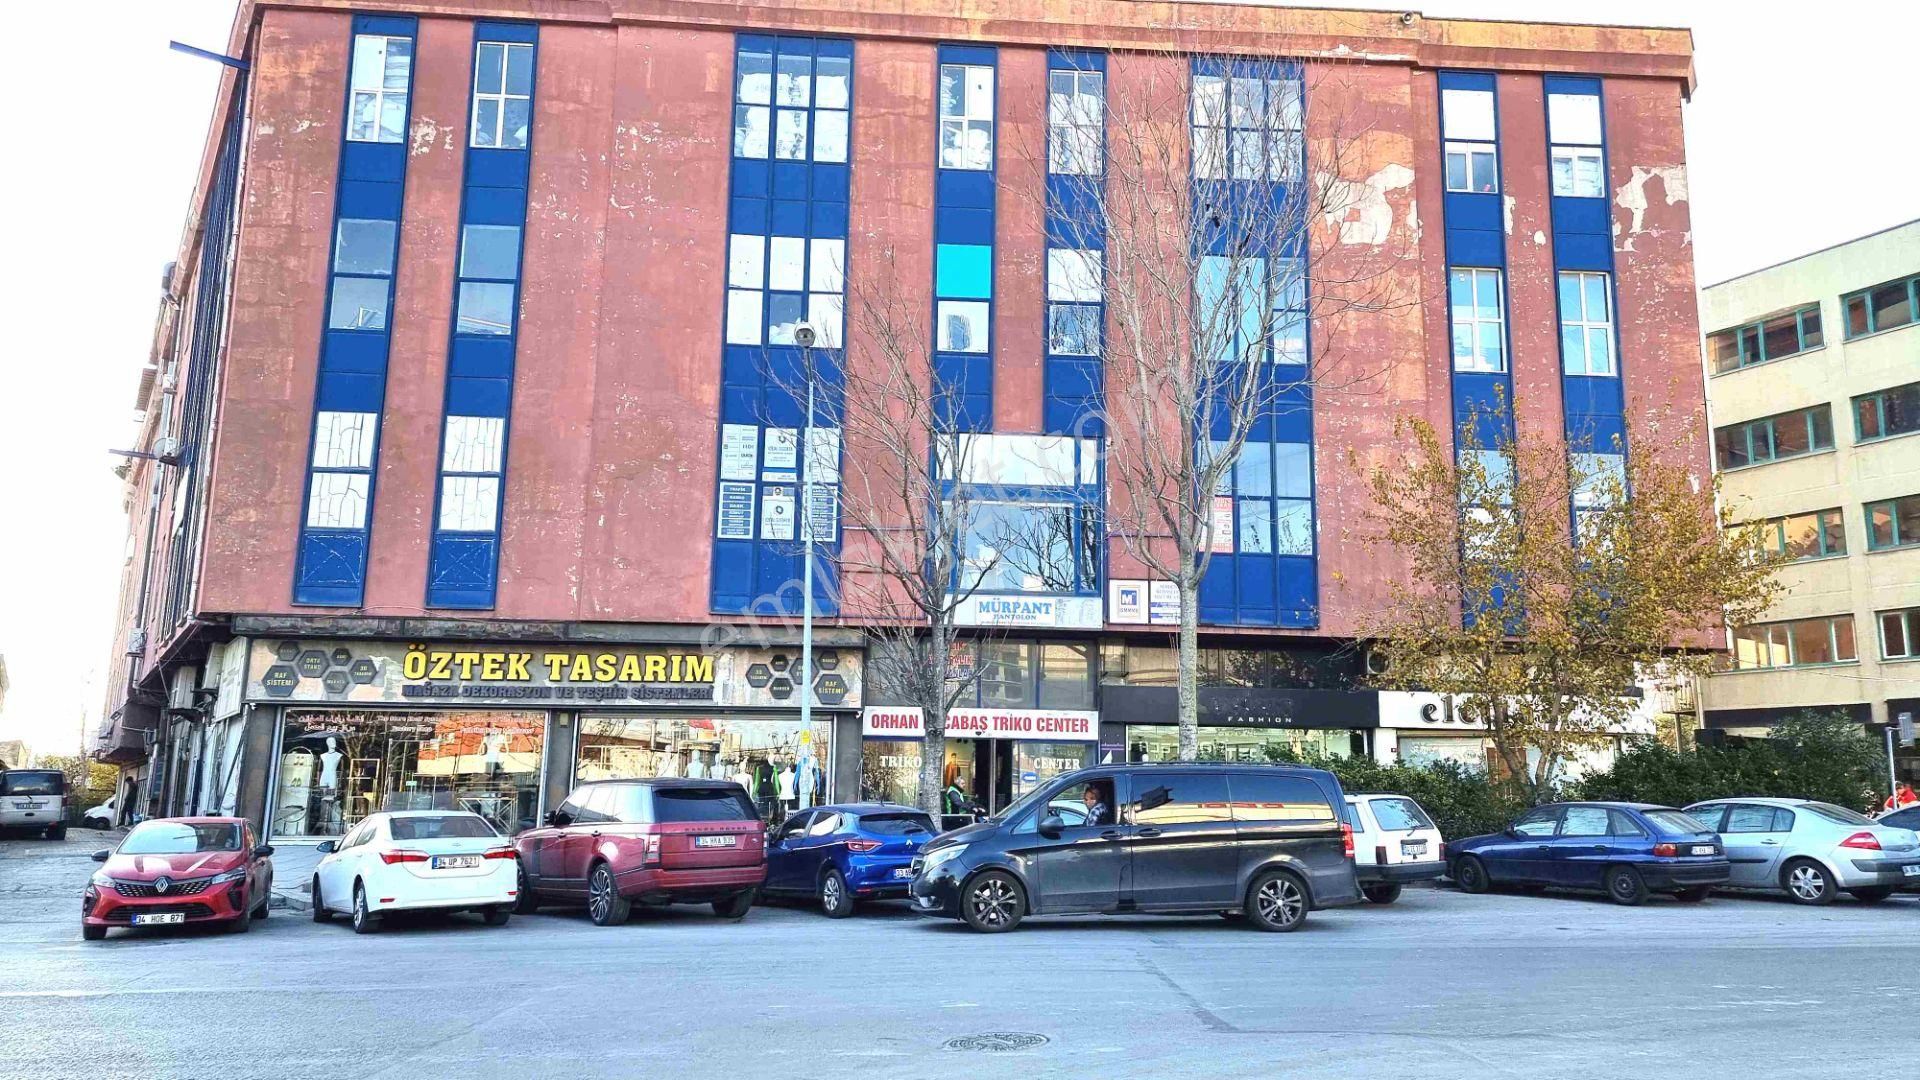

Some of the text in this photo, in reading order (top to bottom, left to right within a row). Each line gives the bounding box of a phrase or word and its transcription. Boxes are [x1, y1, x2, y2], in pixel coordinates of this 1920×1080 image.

[979, 597, 1052, 615] MÜRPANT
[993, 613, 1037, 621] PANTOLON
[403, 643, 715, 683] ÖZTEK TASARIM
[461, 685, 551, 699] DEKORASYON
[554, 686, 575, 699] VE
[577, 684, 629, 702] TEŞHİR
[630, 684, 715, 700] SİSTEMLERİ
[871, 713, 919, 729] ORHAN
[992, 713, 1032, 732] TRİKO
[1036, 717, 1089, 733] CENTER
[880, 754, 923, 768] TRİKO
[1033, 758, 1081, 770] CENTER
[136, 915, 146, 923] 34
[170, 913, 184, 922] 871
